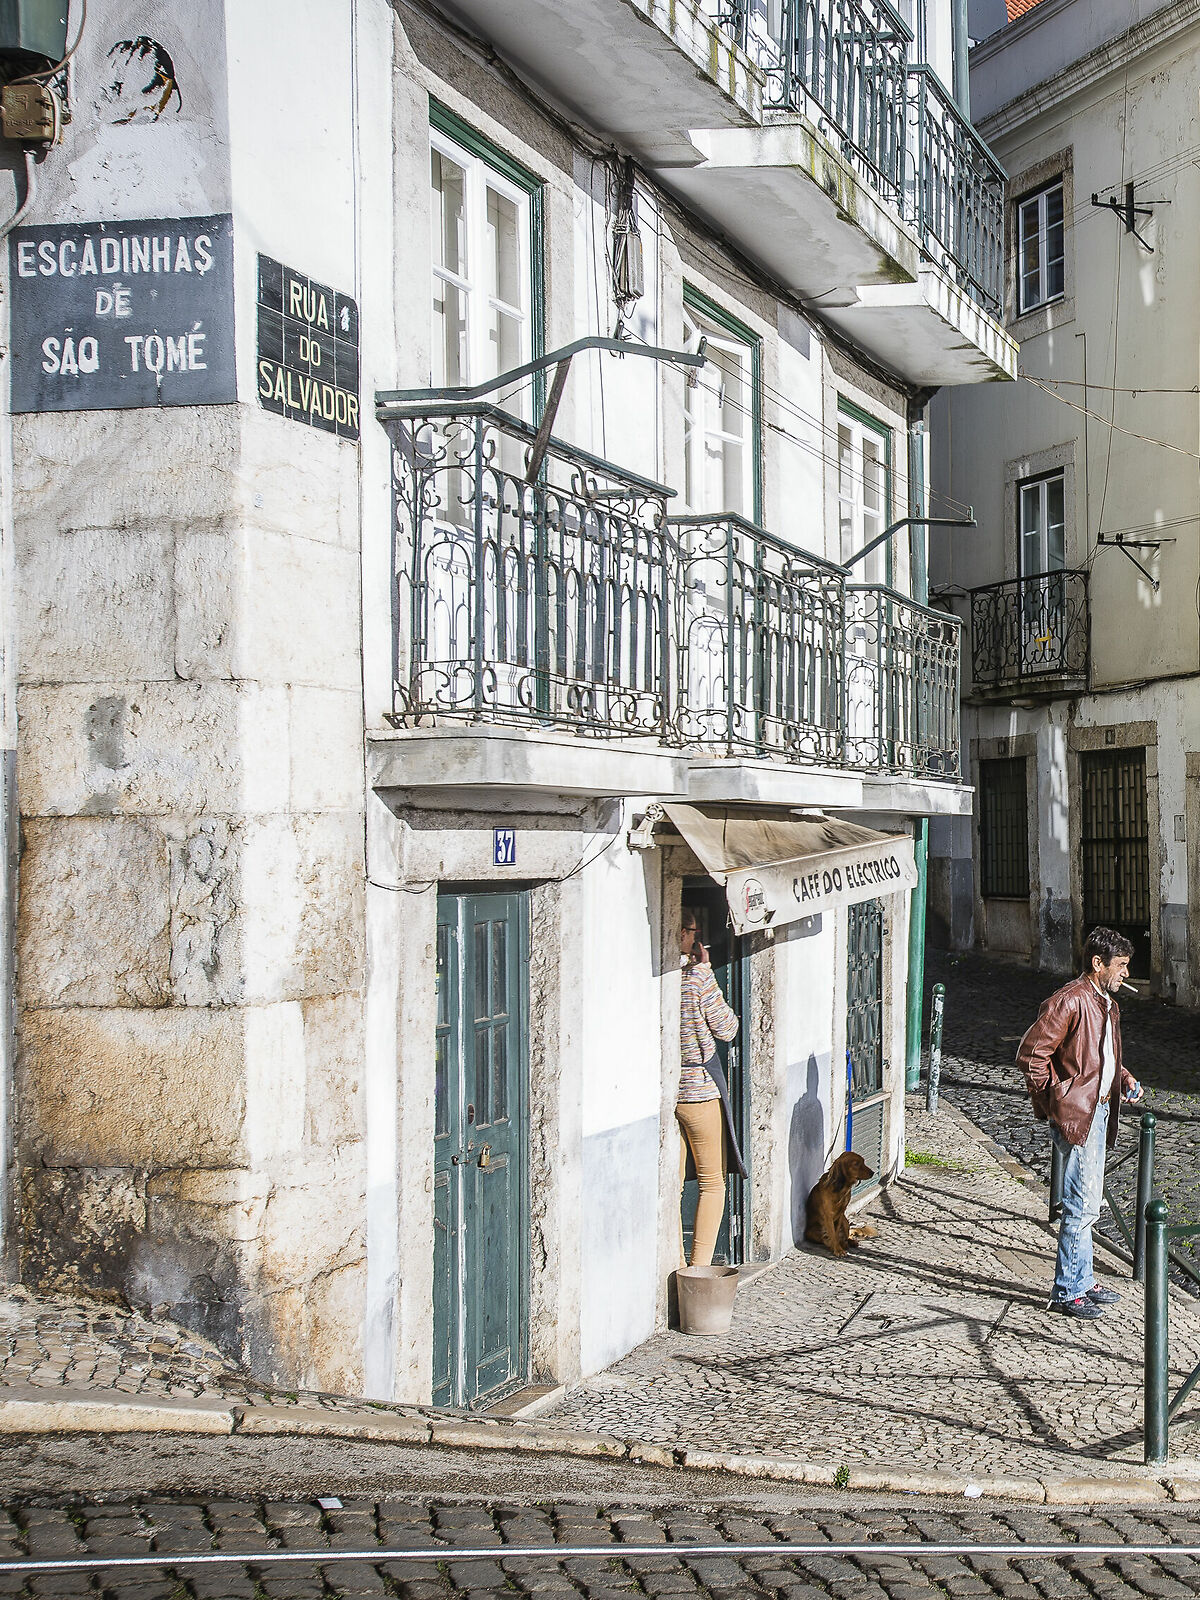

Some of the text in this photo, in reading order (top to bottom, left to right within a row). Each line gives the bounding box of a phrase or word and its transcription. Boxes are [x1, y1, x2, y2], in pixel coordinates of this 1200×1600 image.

[17, 235, 213, 277] ESCADINHAS
[289, 279, 329, 330] RUA
[42, 321, 207, 375] SÃO TOMÉ
[299, 334, 321, 367] DO
[258, 360, 360, 430] SALVADOR
[497, 830, 514, 863] 37
[792, 869, 821, 903] CAFÉ
[822, 867, 843, 895] DO
[845, 855, 901, 889] ELÉCTRICO
